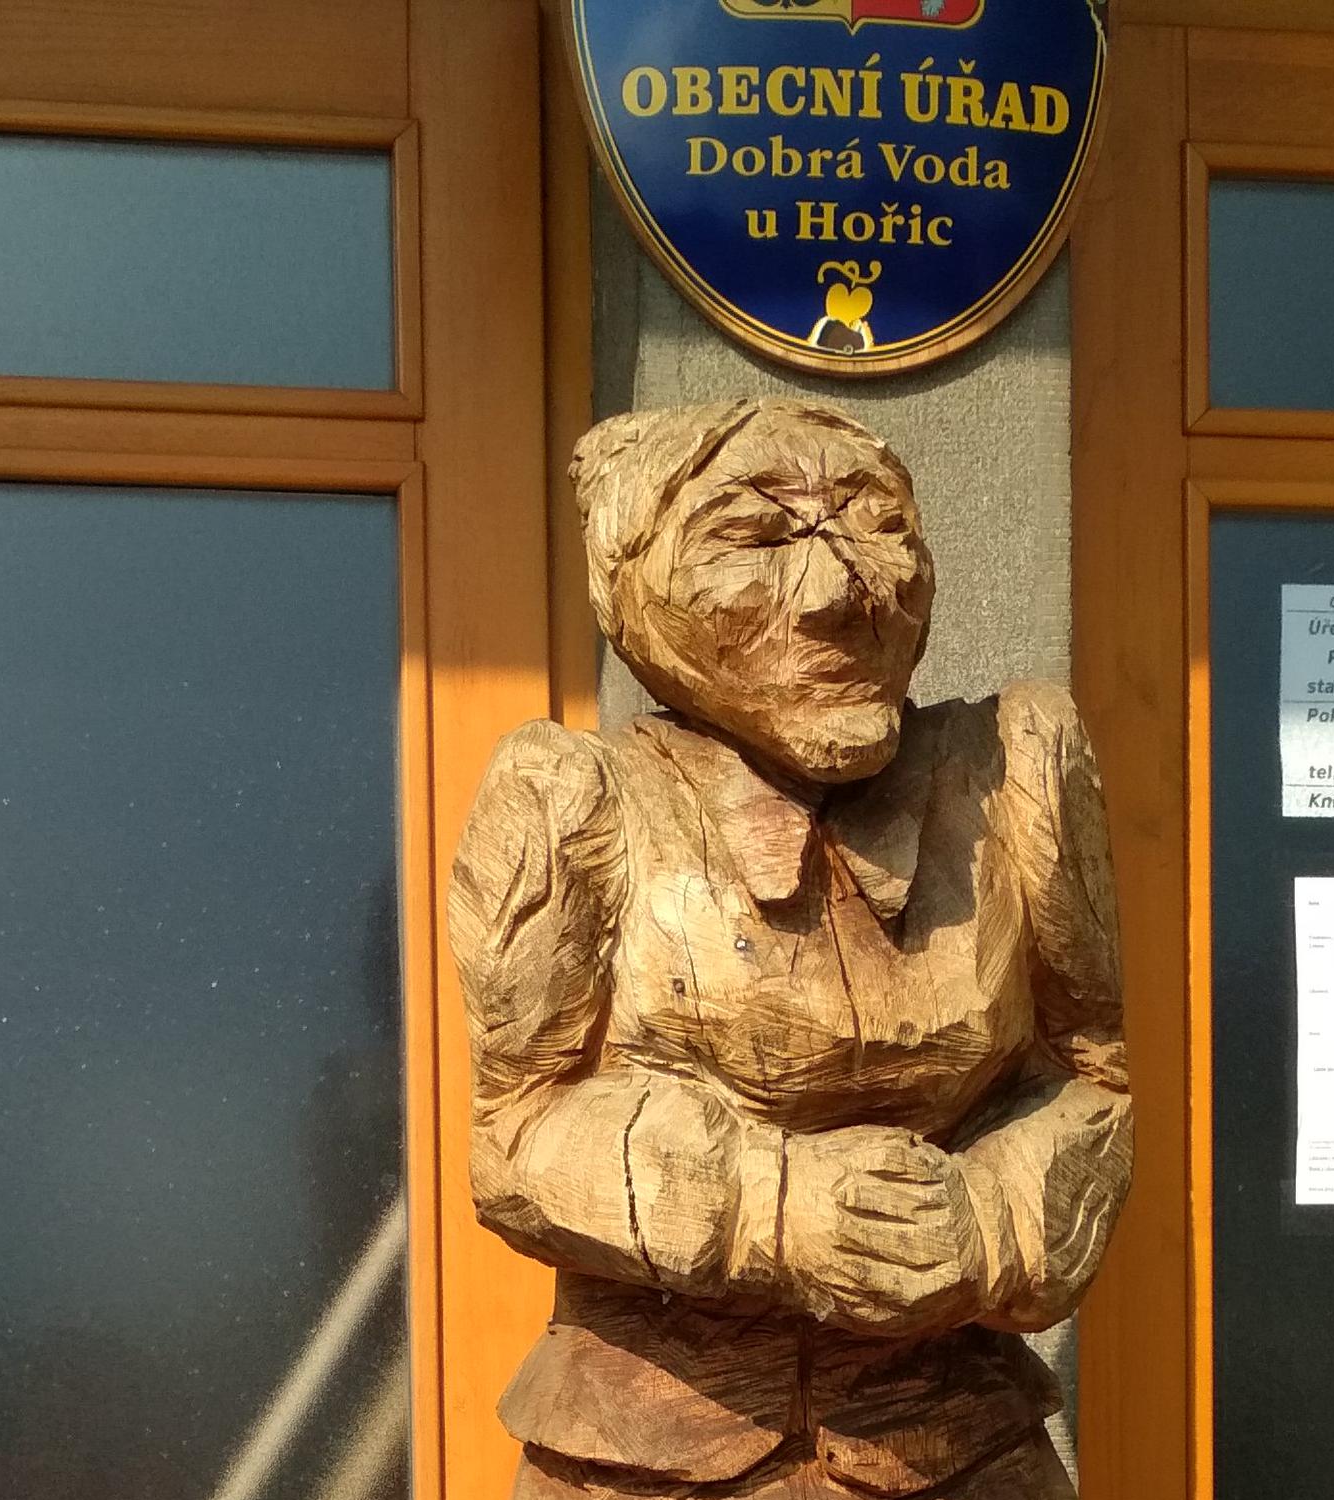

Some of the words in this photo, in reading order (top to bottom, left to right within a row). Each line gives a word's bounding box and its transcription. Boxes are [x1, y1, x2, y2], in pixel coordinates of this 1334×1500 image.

[621, 53, 883, 118] OBECNÍ
[901, 56, 1069, 135] ÚŘAD
[686, 136, 865, 179] Dobrá
[878, 143, 1011, 190] Voda
[745, 208, 778, 239] u
[795, 202, 954, 246] Hořic
